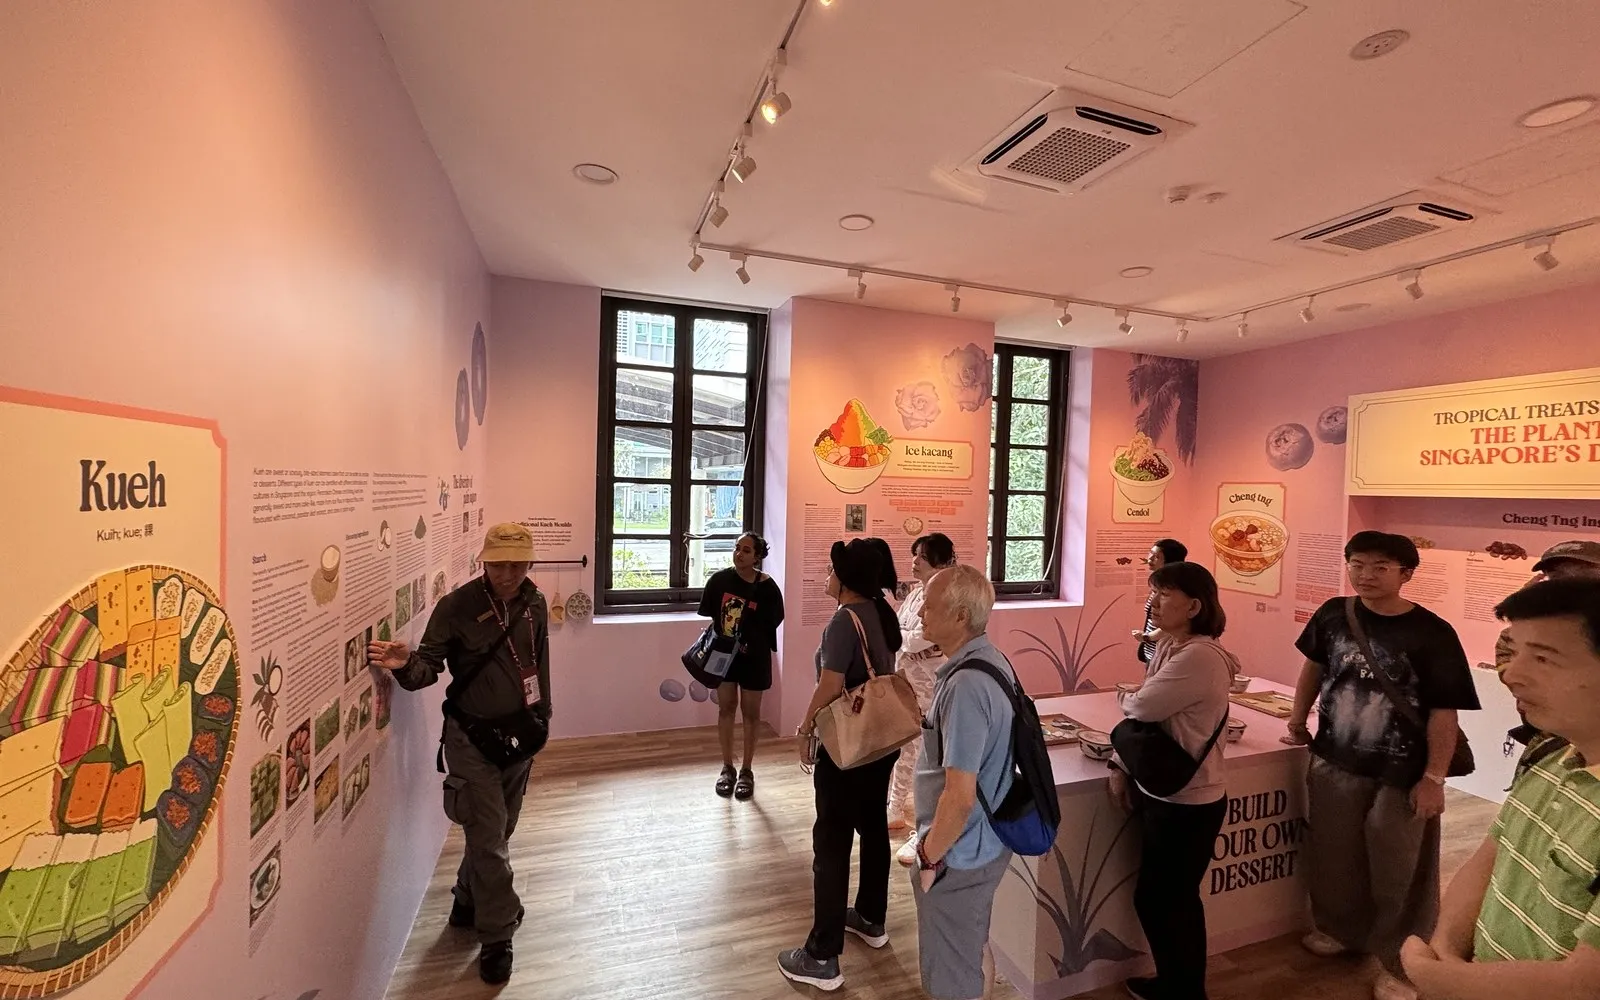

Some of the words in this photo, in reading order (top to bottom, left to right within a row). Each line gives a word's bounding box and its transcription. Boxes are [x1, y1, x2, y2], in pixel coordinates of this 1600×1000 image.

[1434, 407, 1521, 425] TROPICAL
[1525, 399, 1600, 419] TREATS
[1471, 426, 1516, 444] THE
[905, 445, 919, 455] Ice
[921, 446, 953, 459] kacang
[1420, 444, 1580, 466] SINGAPORE'S
[79, 459, 167, 512] Kueh
[1229, 493, 1256, 504] Cheng
[1257, 494, 1273, 507] tng
[1127, 508, 1150, 516] Cendol
[1502, 513, 1548, 527] Cheng
[1551, 515, 1579, 528] Tng
[1228, 790, 1287, 825] BUILD
[1211, 827, 1257, 861] OUR
[1210, 850, 1298, 895] DESSERT
